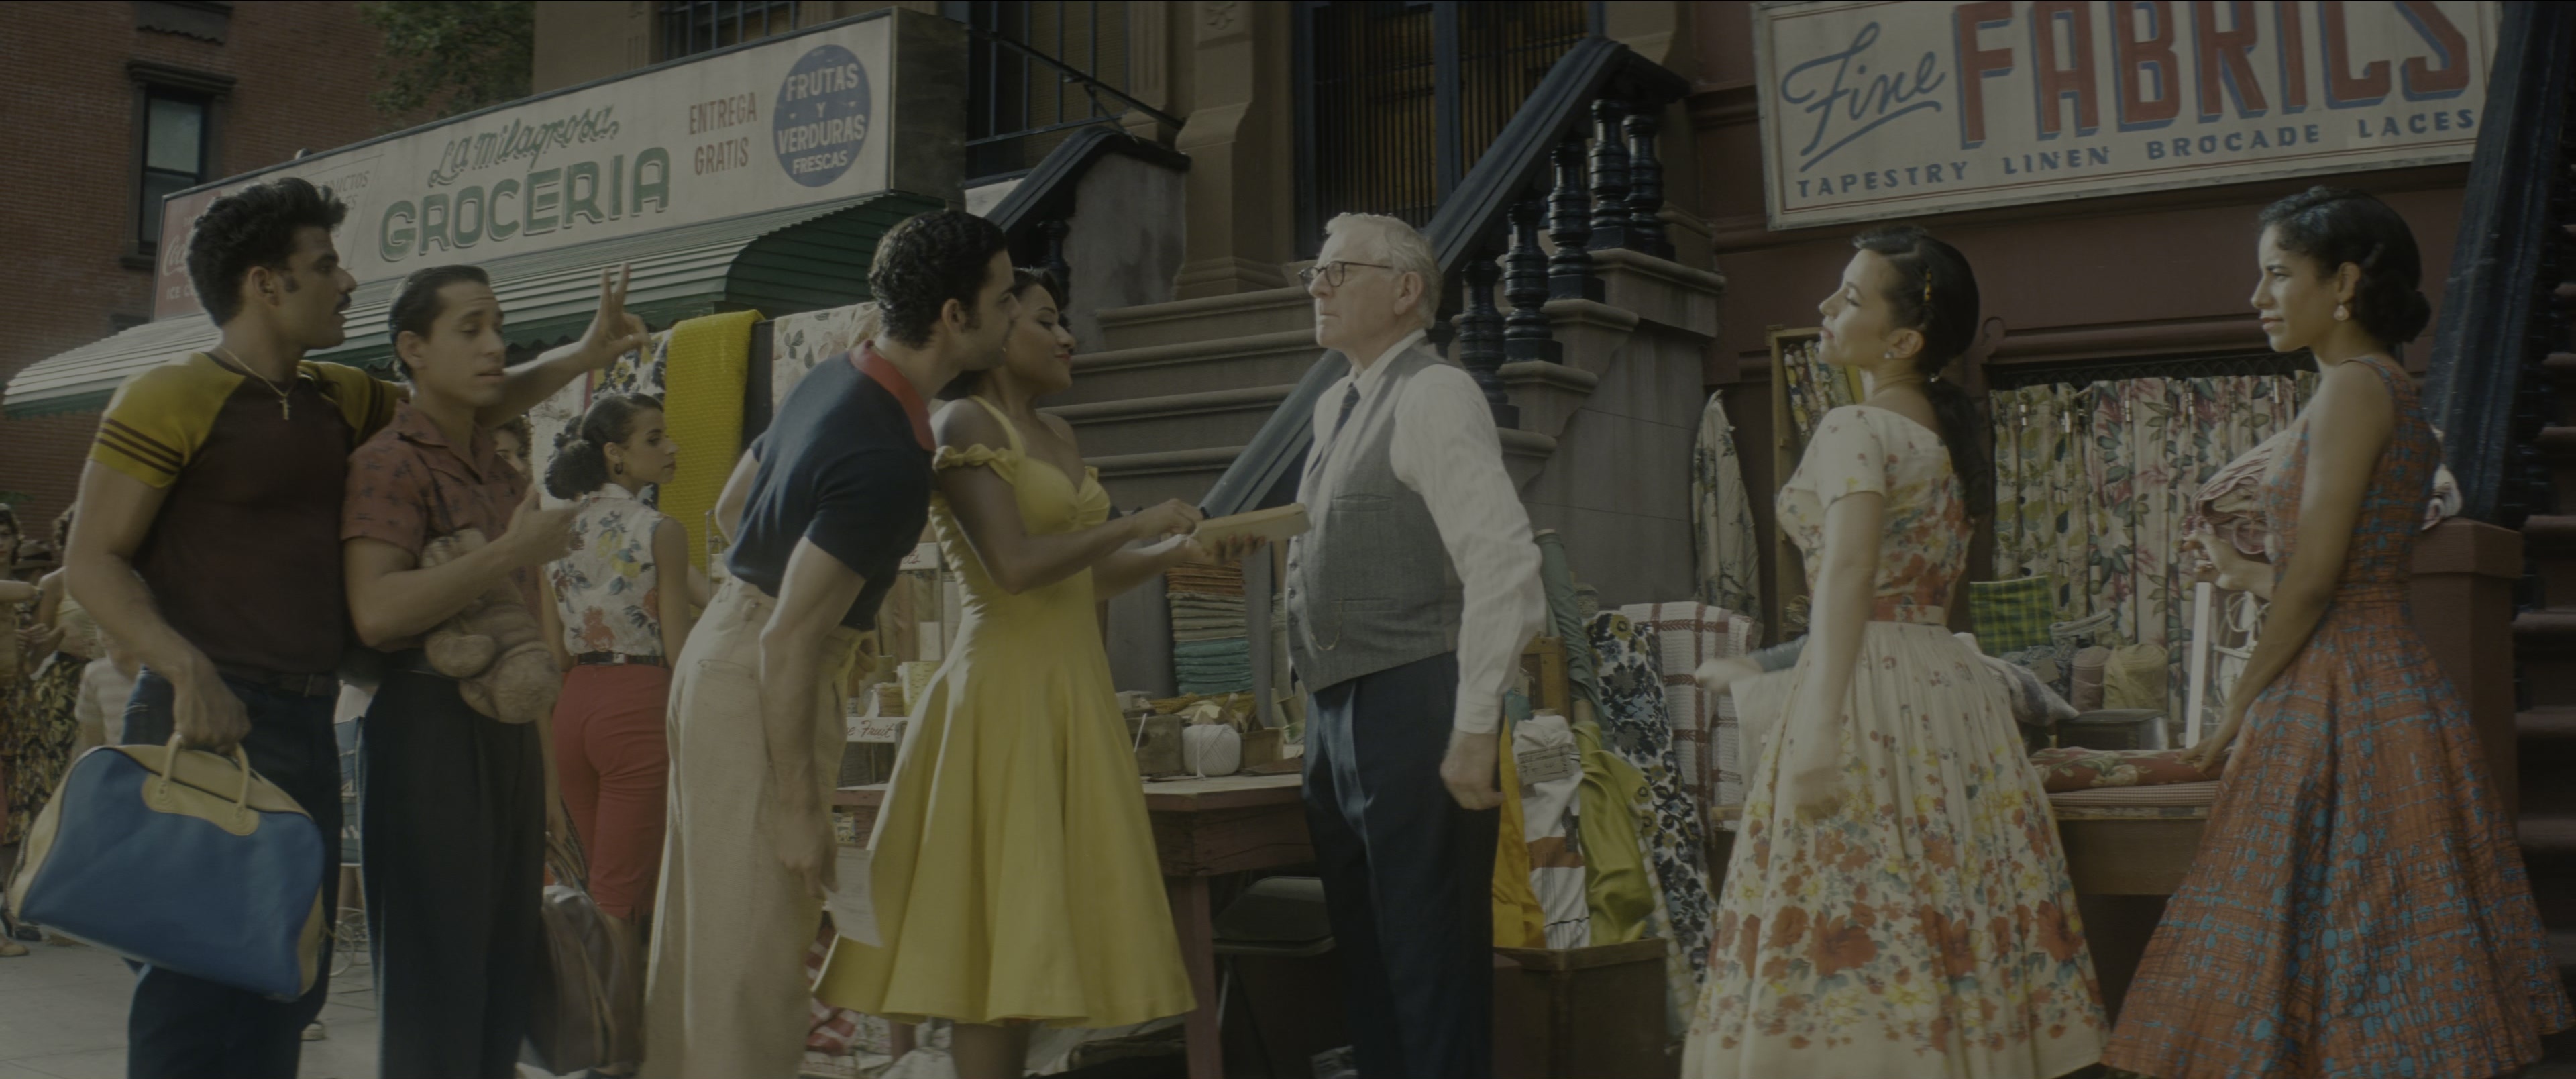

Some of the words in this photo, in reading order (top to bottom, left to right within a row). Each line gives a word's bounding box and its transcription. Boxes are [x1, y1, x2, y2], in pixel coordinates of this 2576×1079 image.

[786, 63, 859, 101] FRUTAS
[1781, 21, 1945, 156] Fine
[1953, 1, 2470, 150] FABRICS
[688, 92, 757, 135] ENTREGA
[816, 101, 827, 118] Y
[777, 114, 865, 154] VERDURAS
[1796, 162, 1968, 198] TAPESTRY
[2002, 146, 2110, 175] LINEN
[2146, 124, 2320, 160] BROCADE
[2358, 109, 2475, 138] LACES
[429, 139, 473, 187] La
[694, 137, 750, 176] GRATIS
[793, 150, 848, 175] FRESCAS
[379, 146, 671, 262] GROCERIA
[861, 720, 895, 738] Fruit
